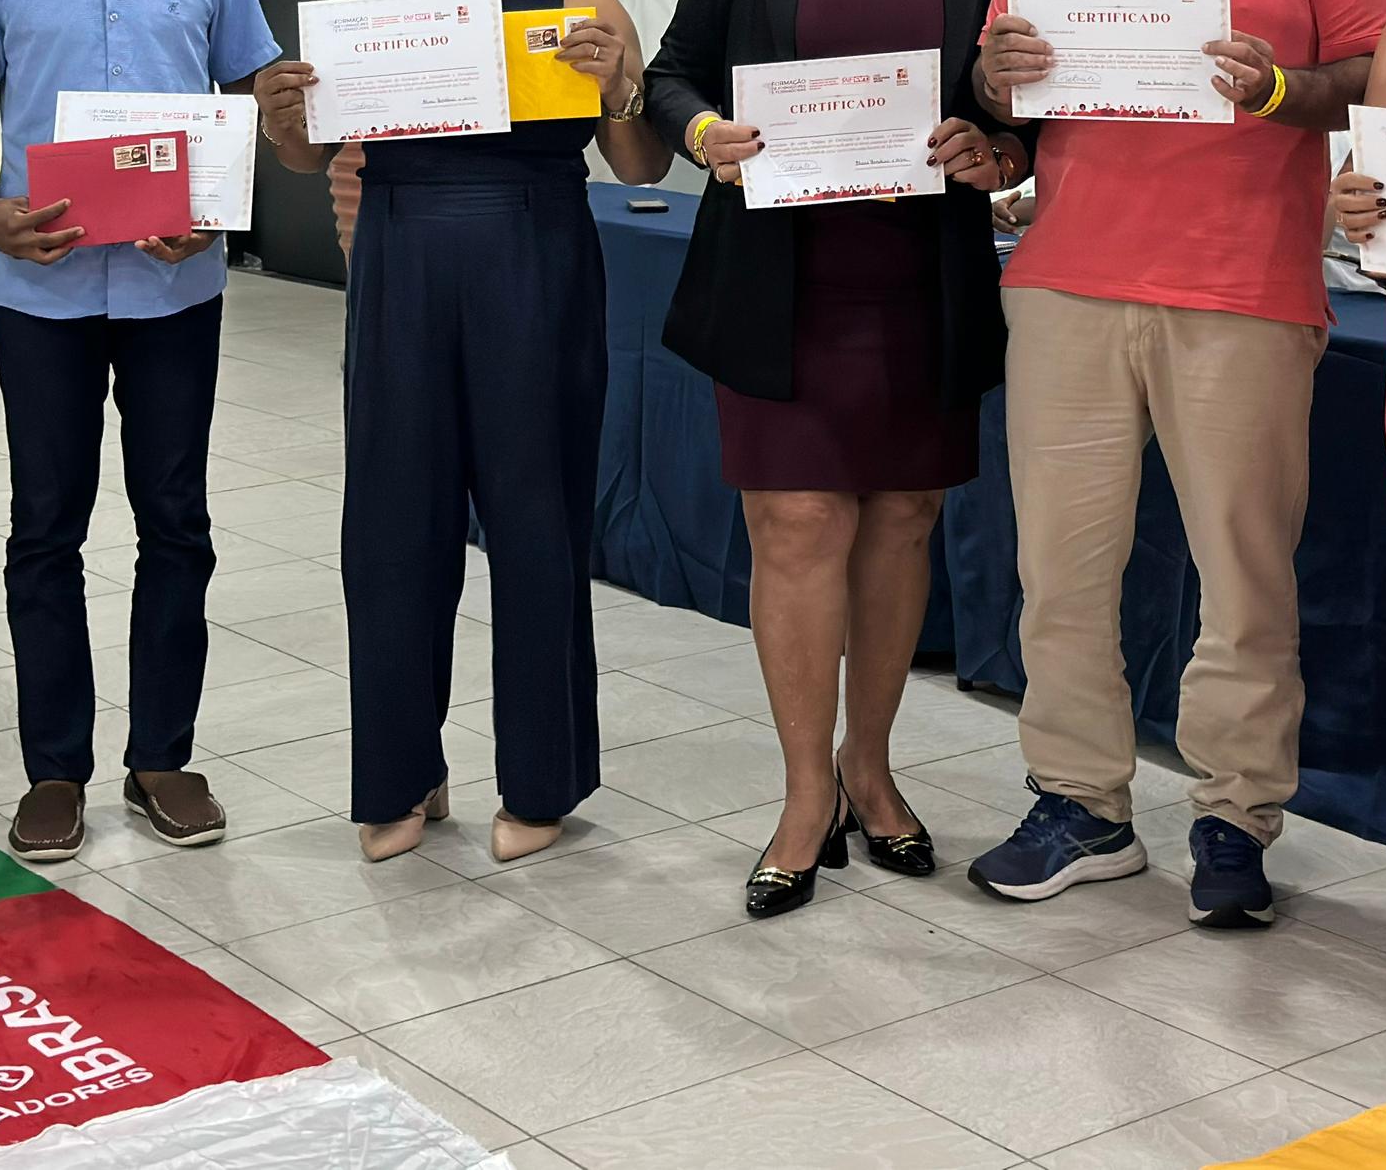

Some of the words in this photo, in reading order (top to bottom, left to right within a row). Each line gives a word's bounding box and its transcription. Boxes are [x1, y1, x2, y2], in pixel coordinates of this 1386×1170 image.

[1067, 12, 1171, 23] CERTIFICADO
[354, 35, 449, 53] CERTIFICADO
[790, 97, 886, 114] CERTIFICADO
